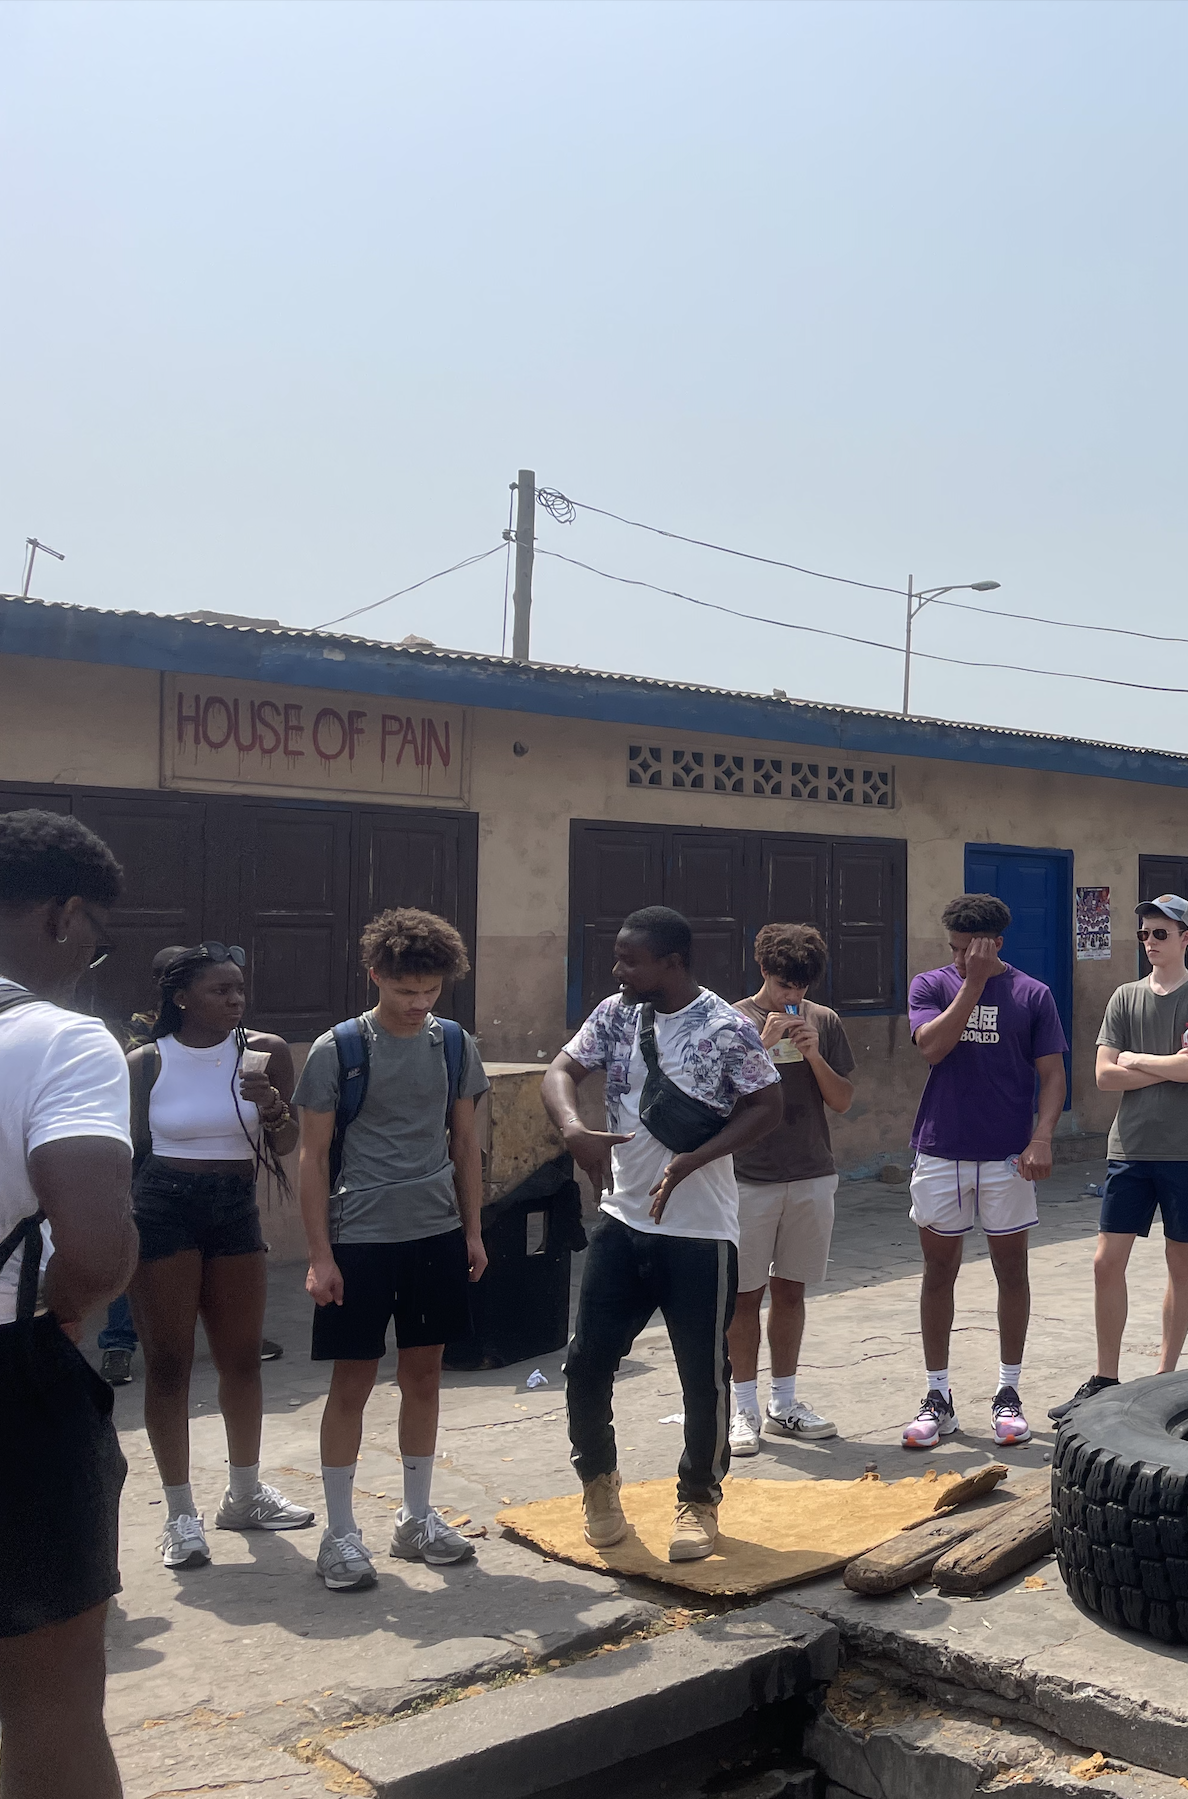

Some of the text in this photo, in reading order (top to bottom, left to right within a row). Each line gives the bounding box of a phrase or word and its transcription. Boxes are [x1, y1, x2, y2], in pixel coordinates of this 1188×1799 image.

[177, 692, 451, 768] HOUSE OF PAIN
[960, 1030, 1000, 1044] BORED
[249, 1507, 269, 1521] N
